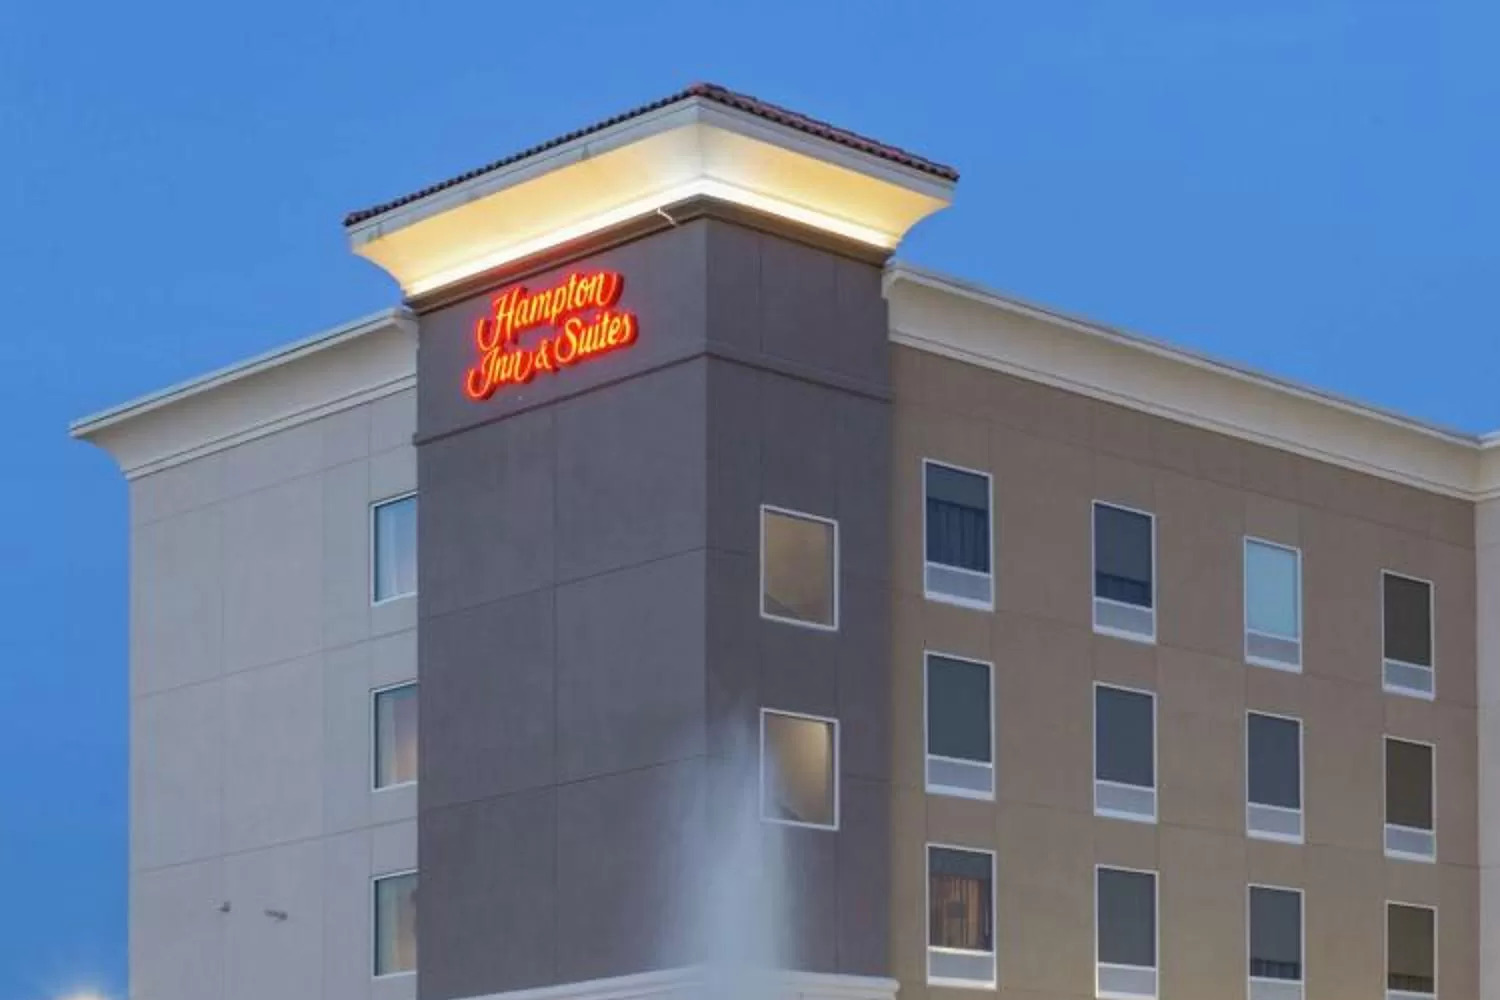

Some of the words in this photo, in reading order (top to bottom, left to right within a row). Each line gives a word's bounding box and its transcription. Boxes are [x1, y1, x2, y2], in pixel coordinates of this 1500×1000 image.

[476, 269, 623, 351] Hampton
[466, 346, 533, 398] Inn
[534, 338, 557, 371] &
[554, 311, 638, 364] Suites
